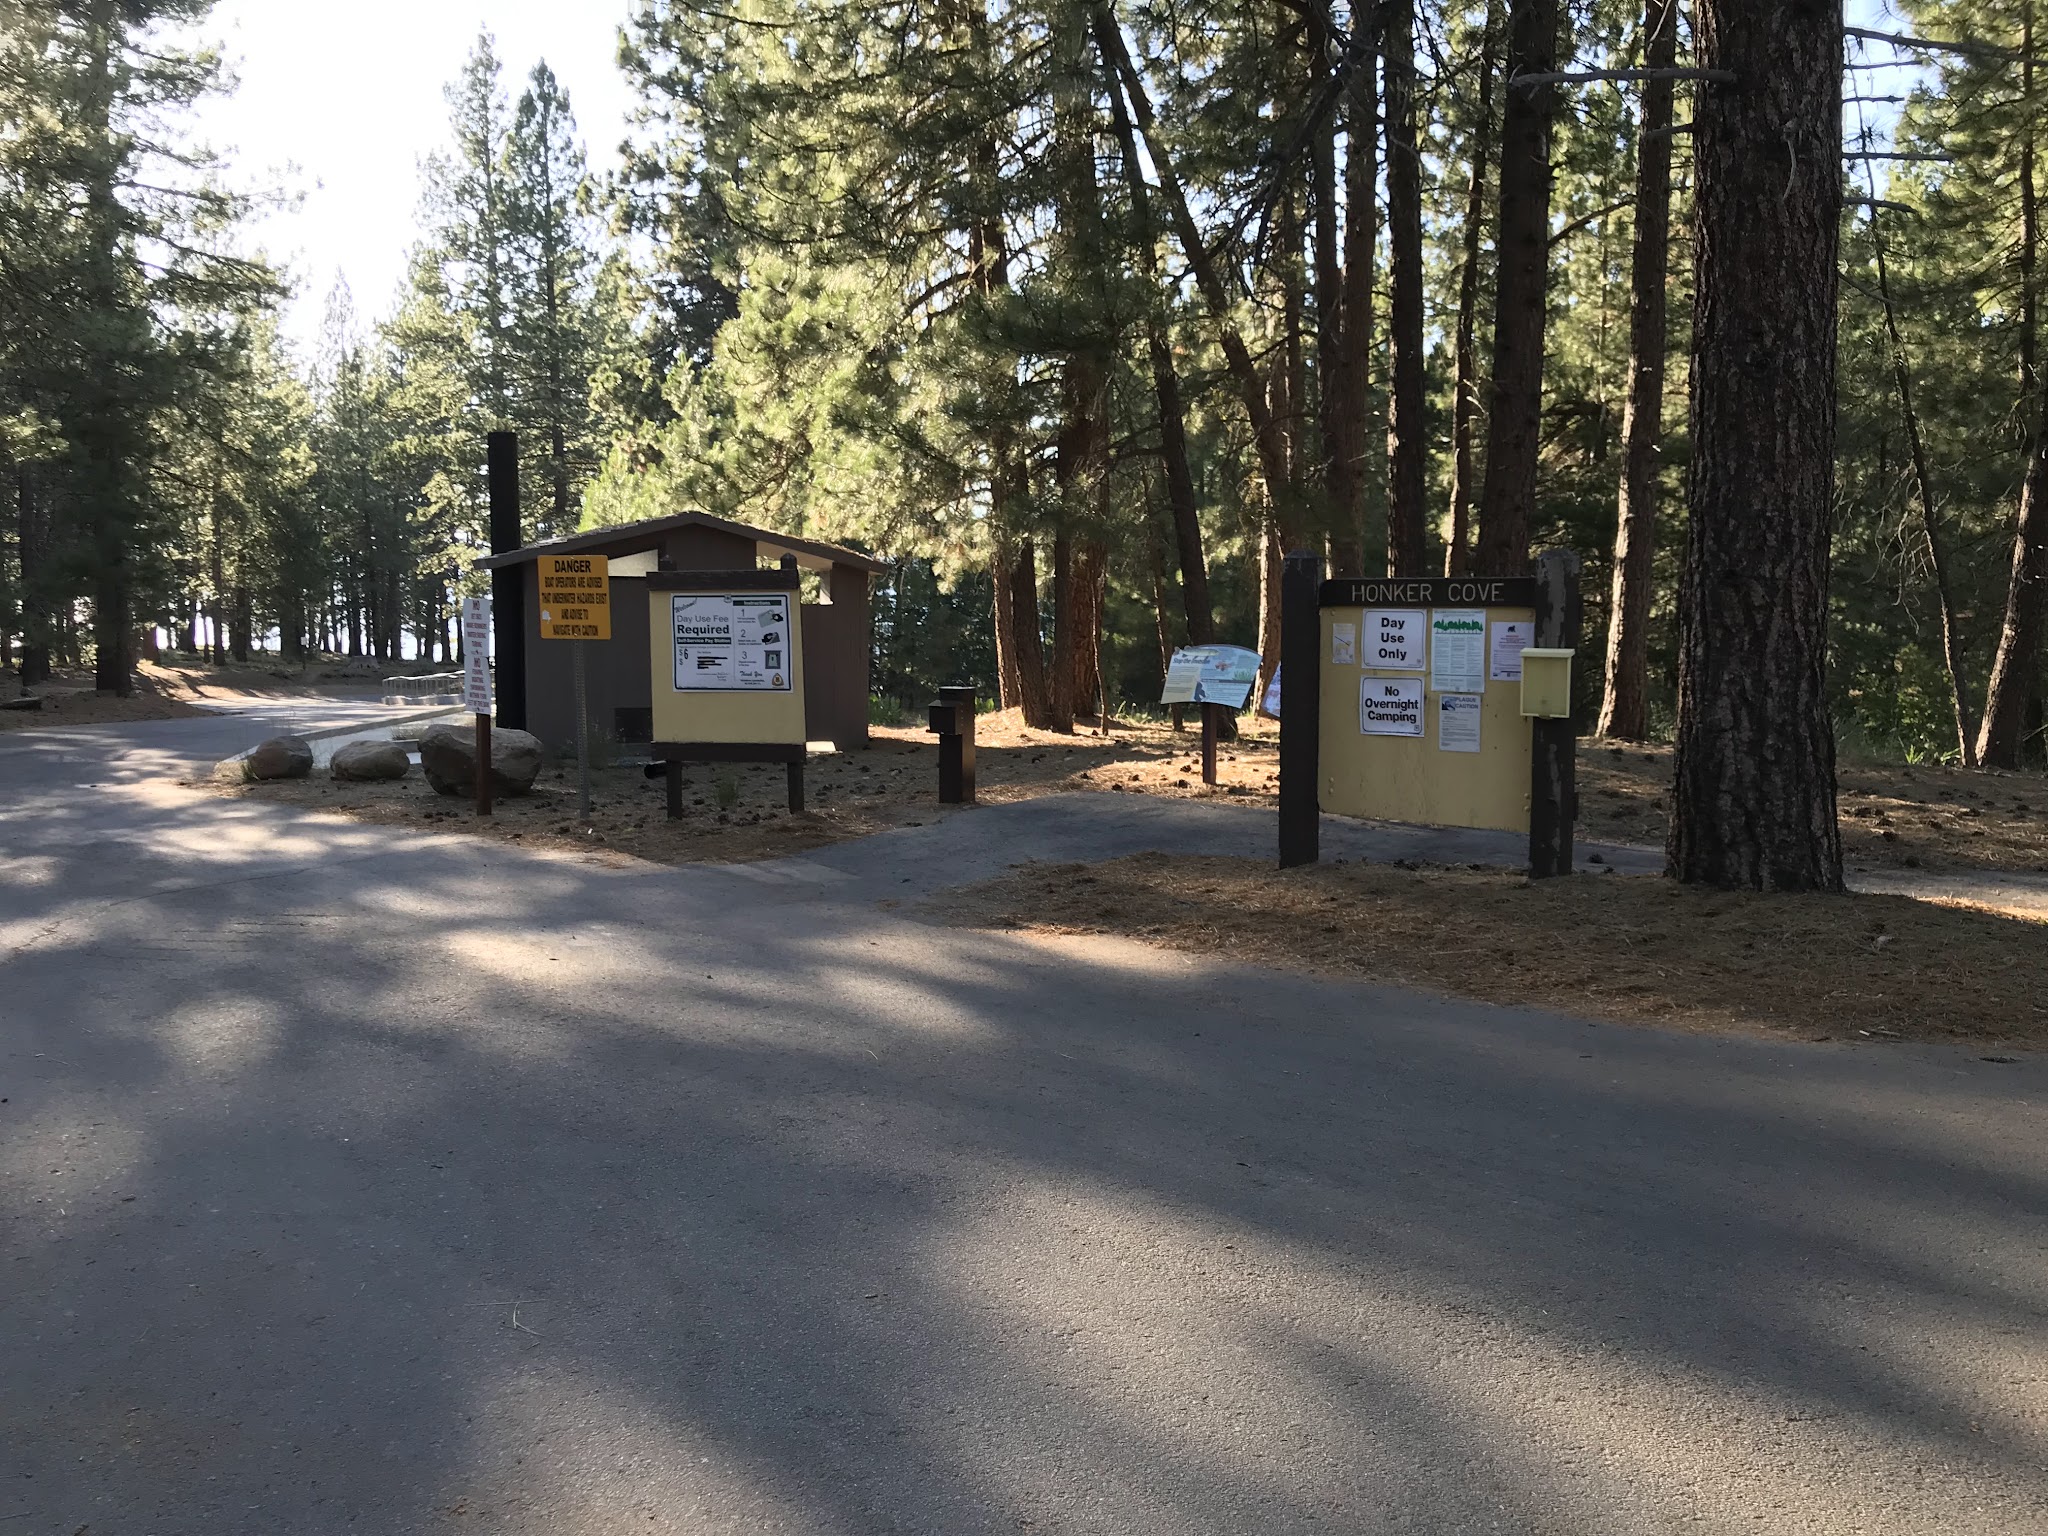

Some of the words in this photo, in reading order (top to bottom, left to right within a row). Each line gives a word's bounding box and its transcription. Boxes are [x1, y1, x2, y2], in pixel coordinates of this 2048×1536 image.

[555, 560, 591, 573] DANGER
[545, 576, 554, 588] BOAT
[555, 576, 577, 588] OPERATORS
[578, 577, 586, 588] ARE
[587, 577, 602, 588] ADVISED
[1352, 584, 1432, 602] HONKER
[1448, 583, 1505, 602] COVE
[541, 593, 551, 604] THAT
[552, 593, 575, 604] UNDERWATER
[577, 593, 595, 604] HAZARDS
[596, 593, 607, 604] EXIST
[741, 609, 745, 617] 1
[677, 614, 693, 624] Day
[695, 615, 711, 623] Use
[713, 614, 729, 623] Fee
[1381, 617, 1405, 630] Day
[553, 625, 571, 636] NAVIGATE
[582, 625, 598, 636] CAUTION
[677, 624, 730, 636] Required
[741, 629, 746, 638] 2
[1381, 632, 1405, 643] Use
[742, 651, 747, 660] 3
[1378, 648, 1407, 661] Only
[1385, 686, 1400, 697] No
[1365, 698, 1419, 712] Overnight
[1367, 711, 1417, 725] Camping
